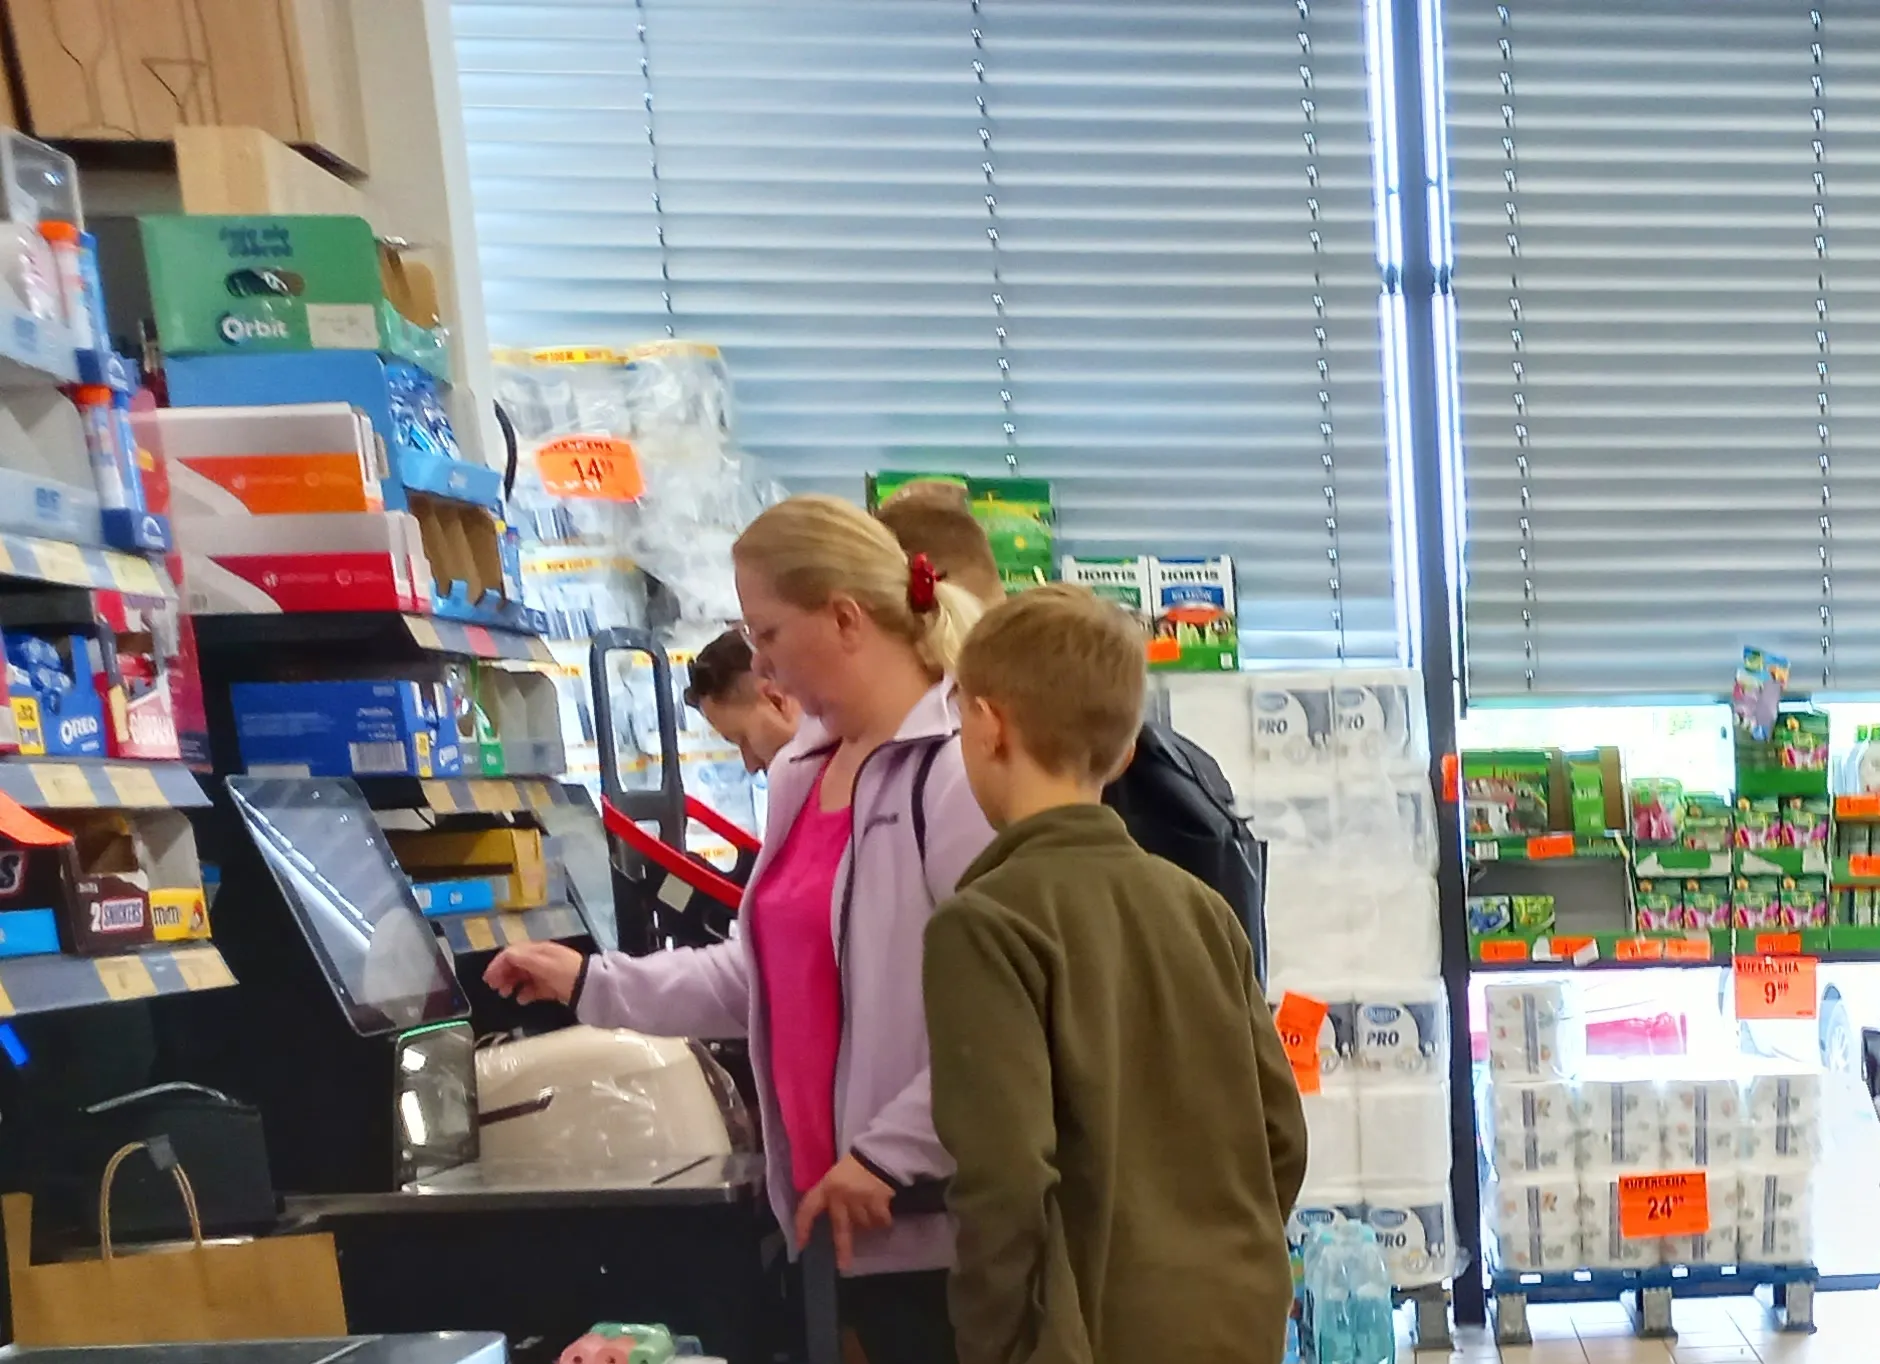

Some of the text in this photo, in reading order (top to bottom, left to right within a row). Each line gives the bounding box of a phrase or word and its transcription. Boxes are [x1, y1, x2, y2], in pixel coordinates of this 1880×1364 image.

[222, 316, 289, 341] Orbit
[60, 715, 98, 745] OREO
[104, 901, 142, 926] SNICKERS
[1764, 982, 1776, 1004] 9
[1366, 1031, 1399, 1046] PRO
[1648, 1196, 1672, 1220] 24
